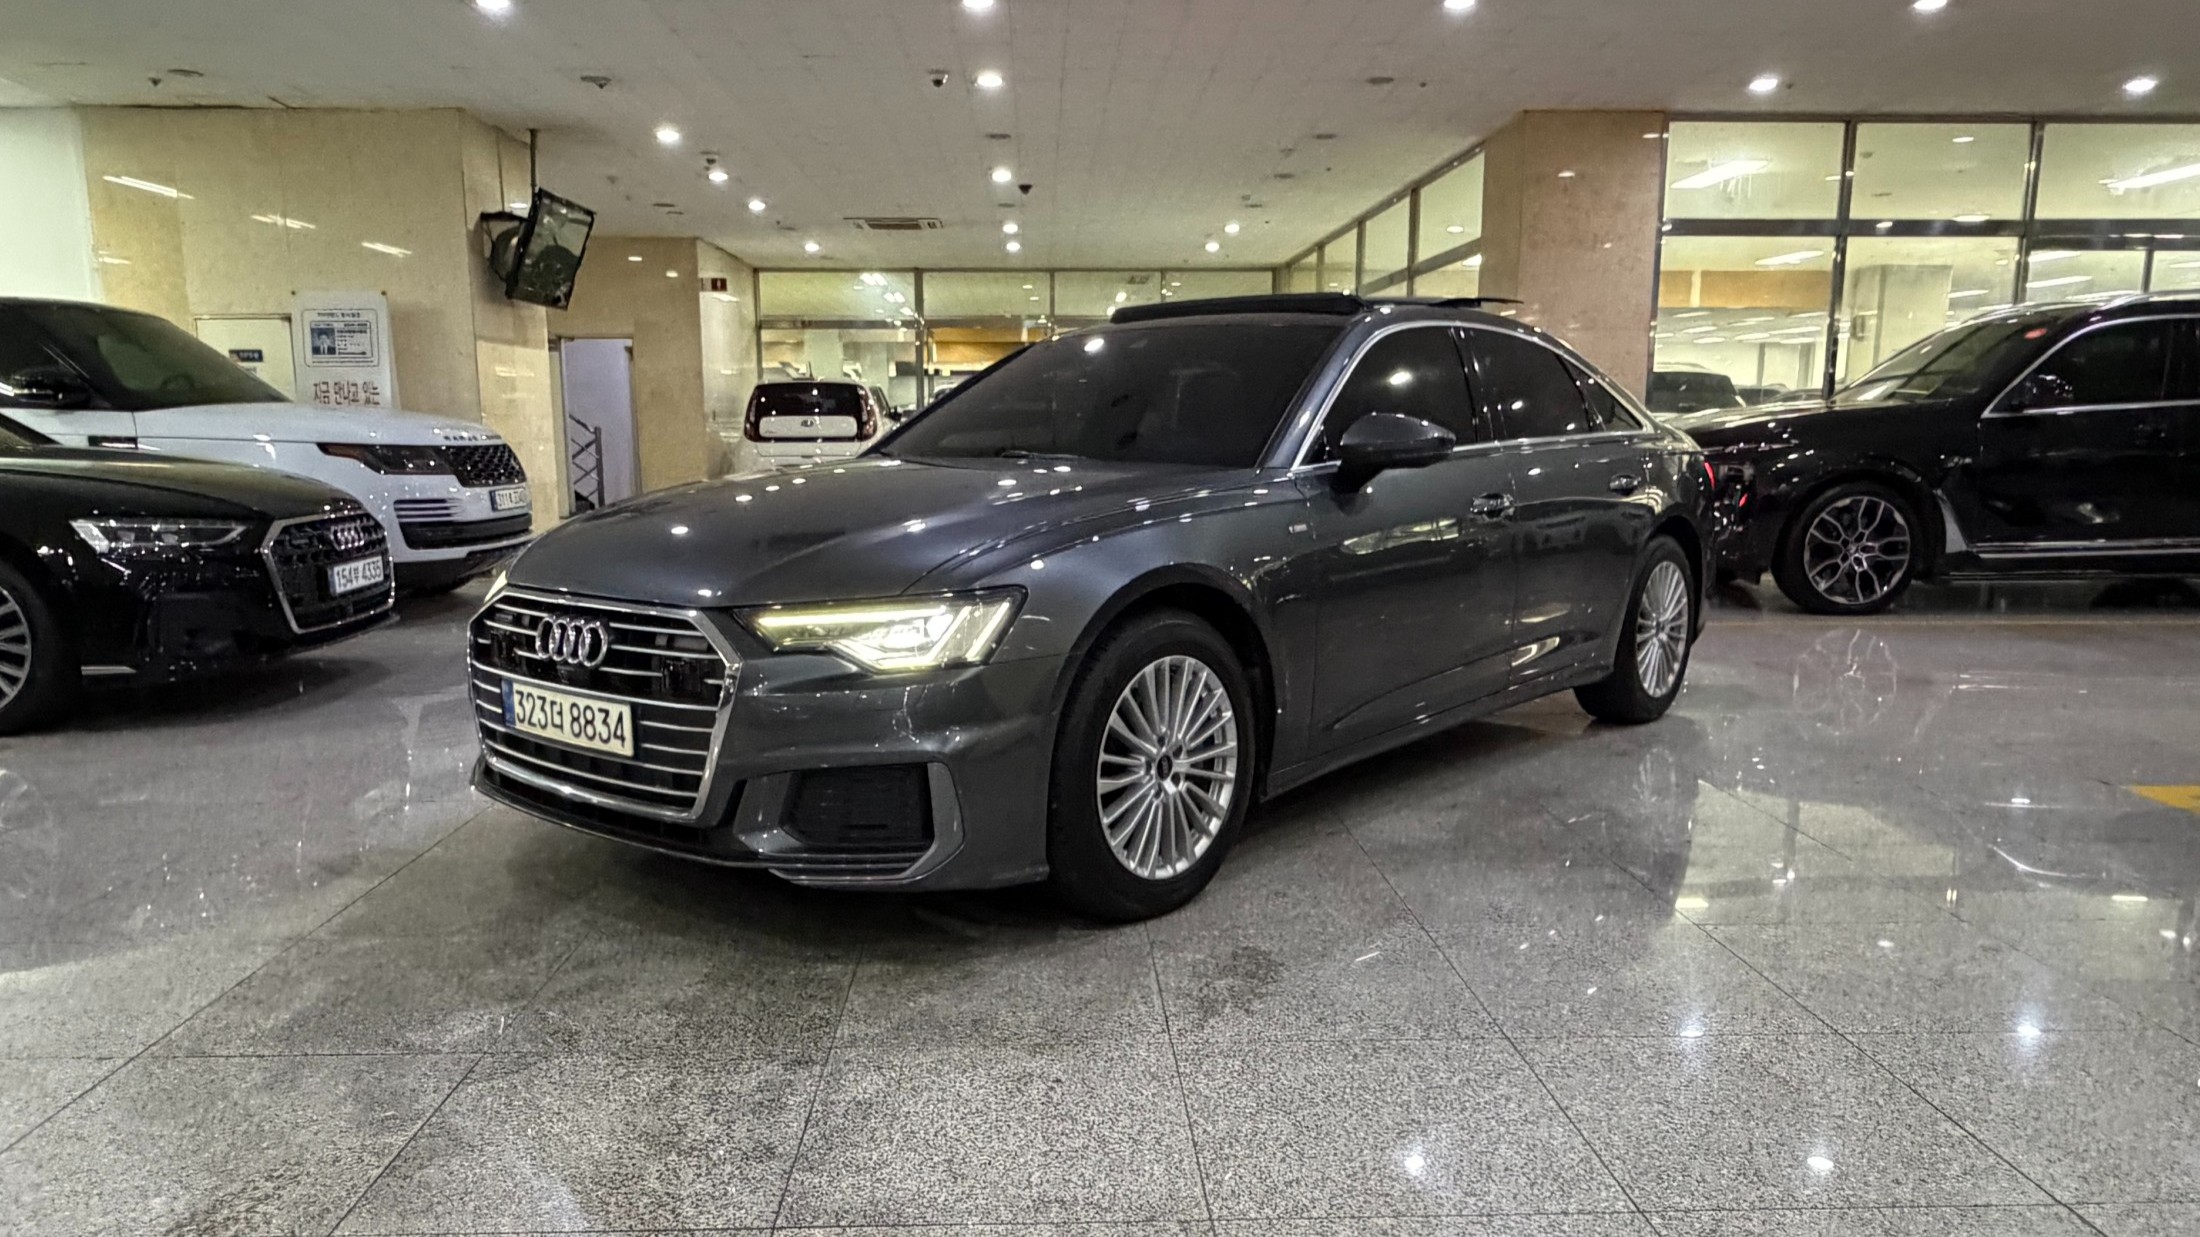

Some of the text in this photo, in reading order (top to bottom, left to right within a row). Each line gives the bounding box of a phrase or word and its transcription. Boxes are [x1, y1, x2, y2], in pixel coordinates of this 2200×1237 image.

[313, 381, 380, 405] 지금 만나고 있는
[515, 689, 626, 748] 323더 8834
